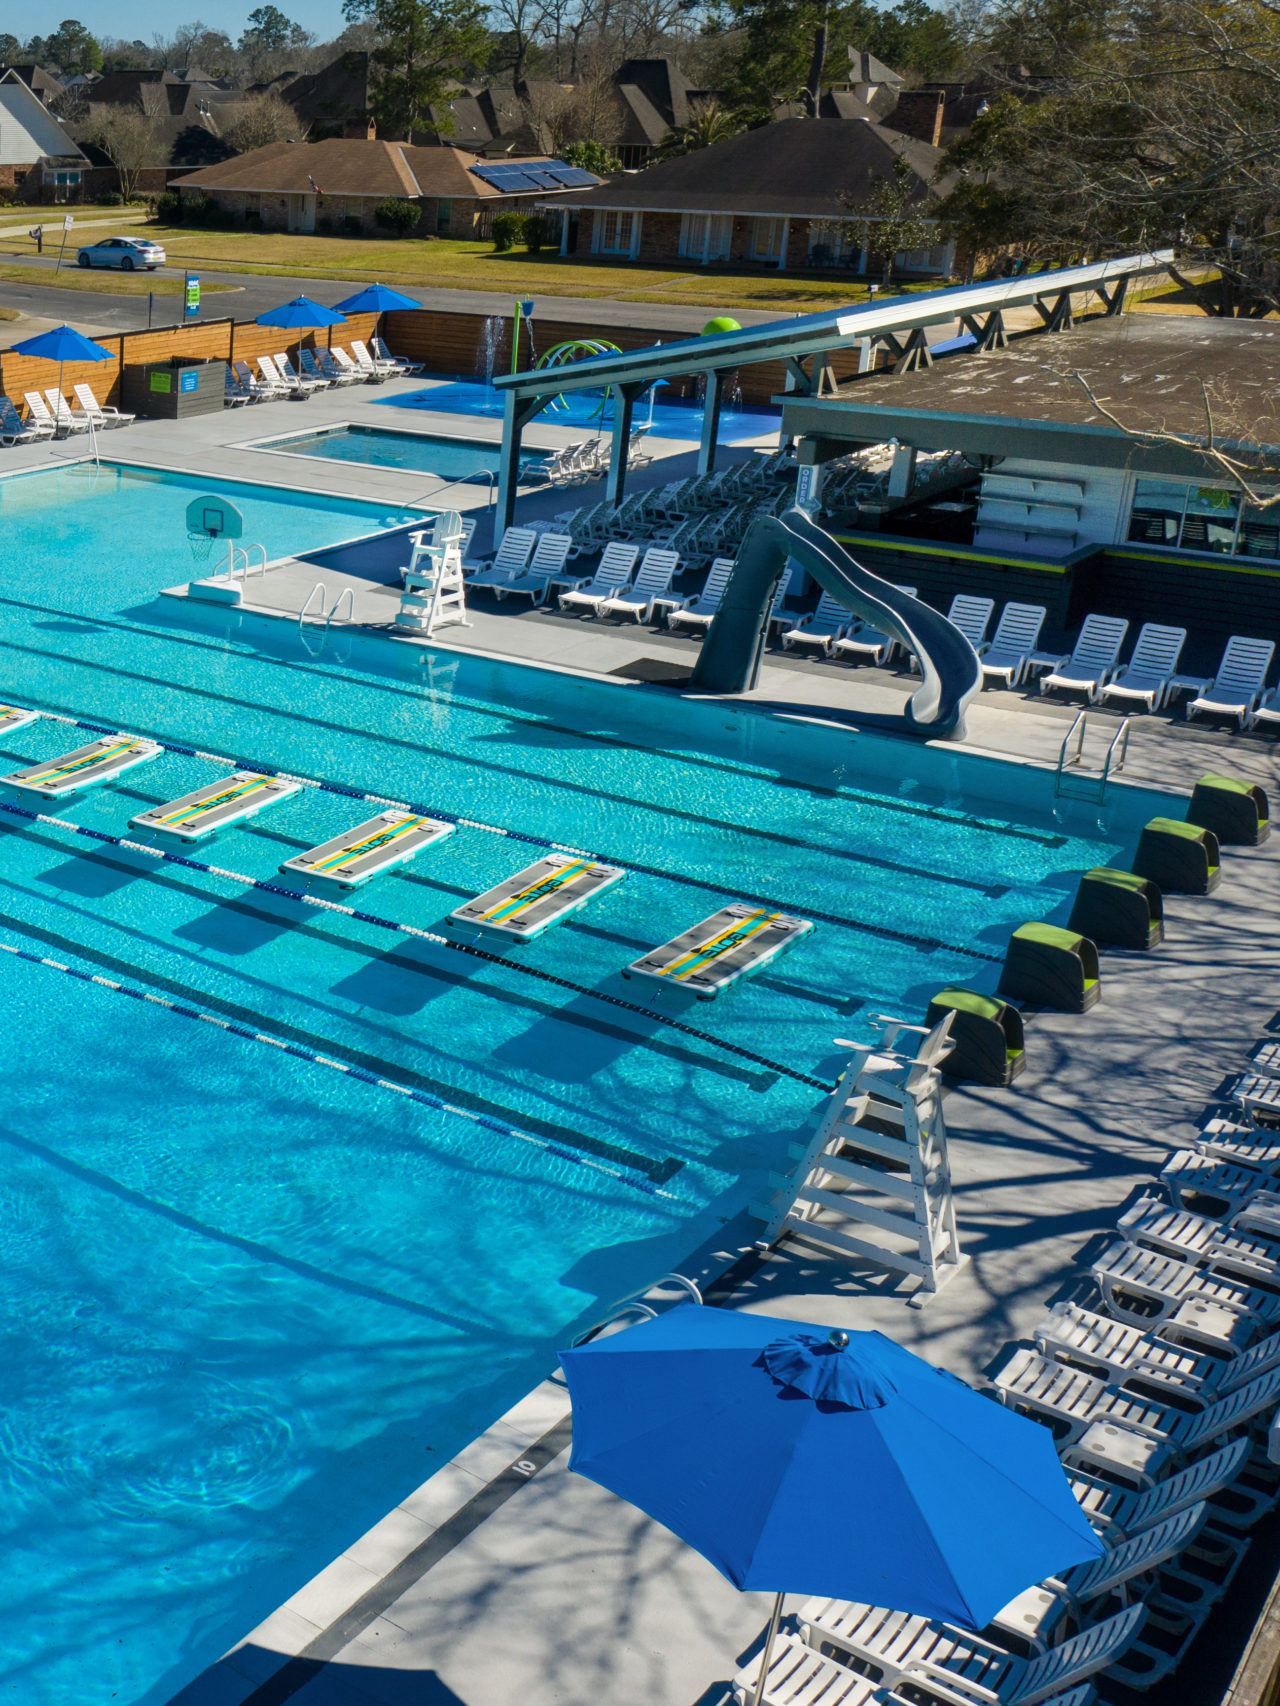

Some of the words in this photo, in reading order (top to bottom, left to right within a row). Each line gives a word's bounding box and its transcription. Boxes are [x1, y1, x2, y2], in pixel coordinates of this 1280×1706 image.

[799, 469, 810, 504] ORDER
[197, 791, 242, 811] BOTE
[350, 833, 396, 855] BOTE
[519, 879, 565, 903] BOTE
[699, 932, 747, 958] BOTE
[511, 1460, 537, 1476] 10
